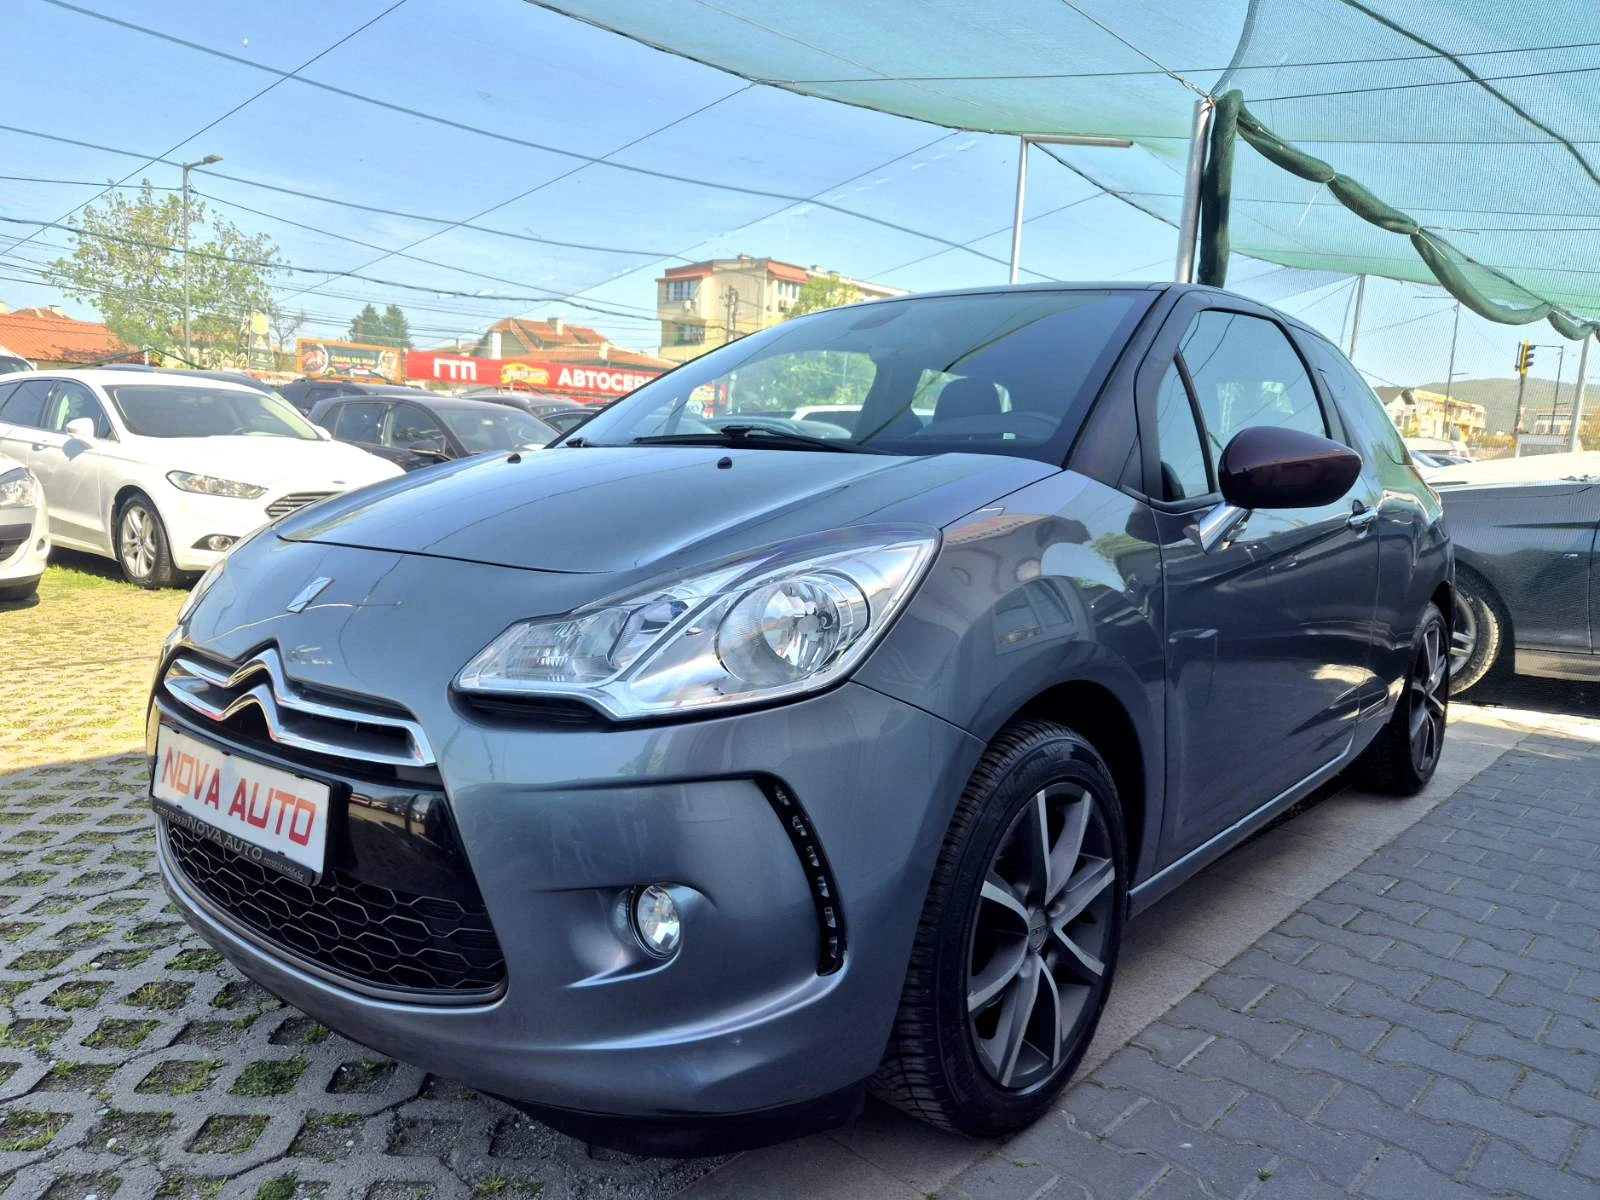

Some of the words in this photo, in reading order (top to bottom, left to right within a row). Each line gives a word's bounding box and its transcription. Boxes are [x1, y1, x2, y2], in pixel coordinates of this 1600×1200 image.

[433, 358, 476, 380] ГТП
[558, 368, 656, 391] АВТОСЕР
[161, 747, 221, 810] NOVA
[228, 778, 317, 847] AUTO
[188, 816, 222, 841] NOVA
[224, 838, 263, 861] AUTO
